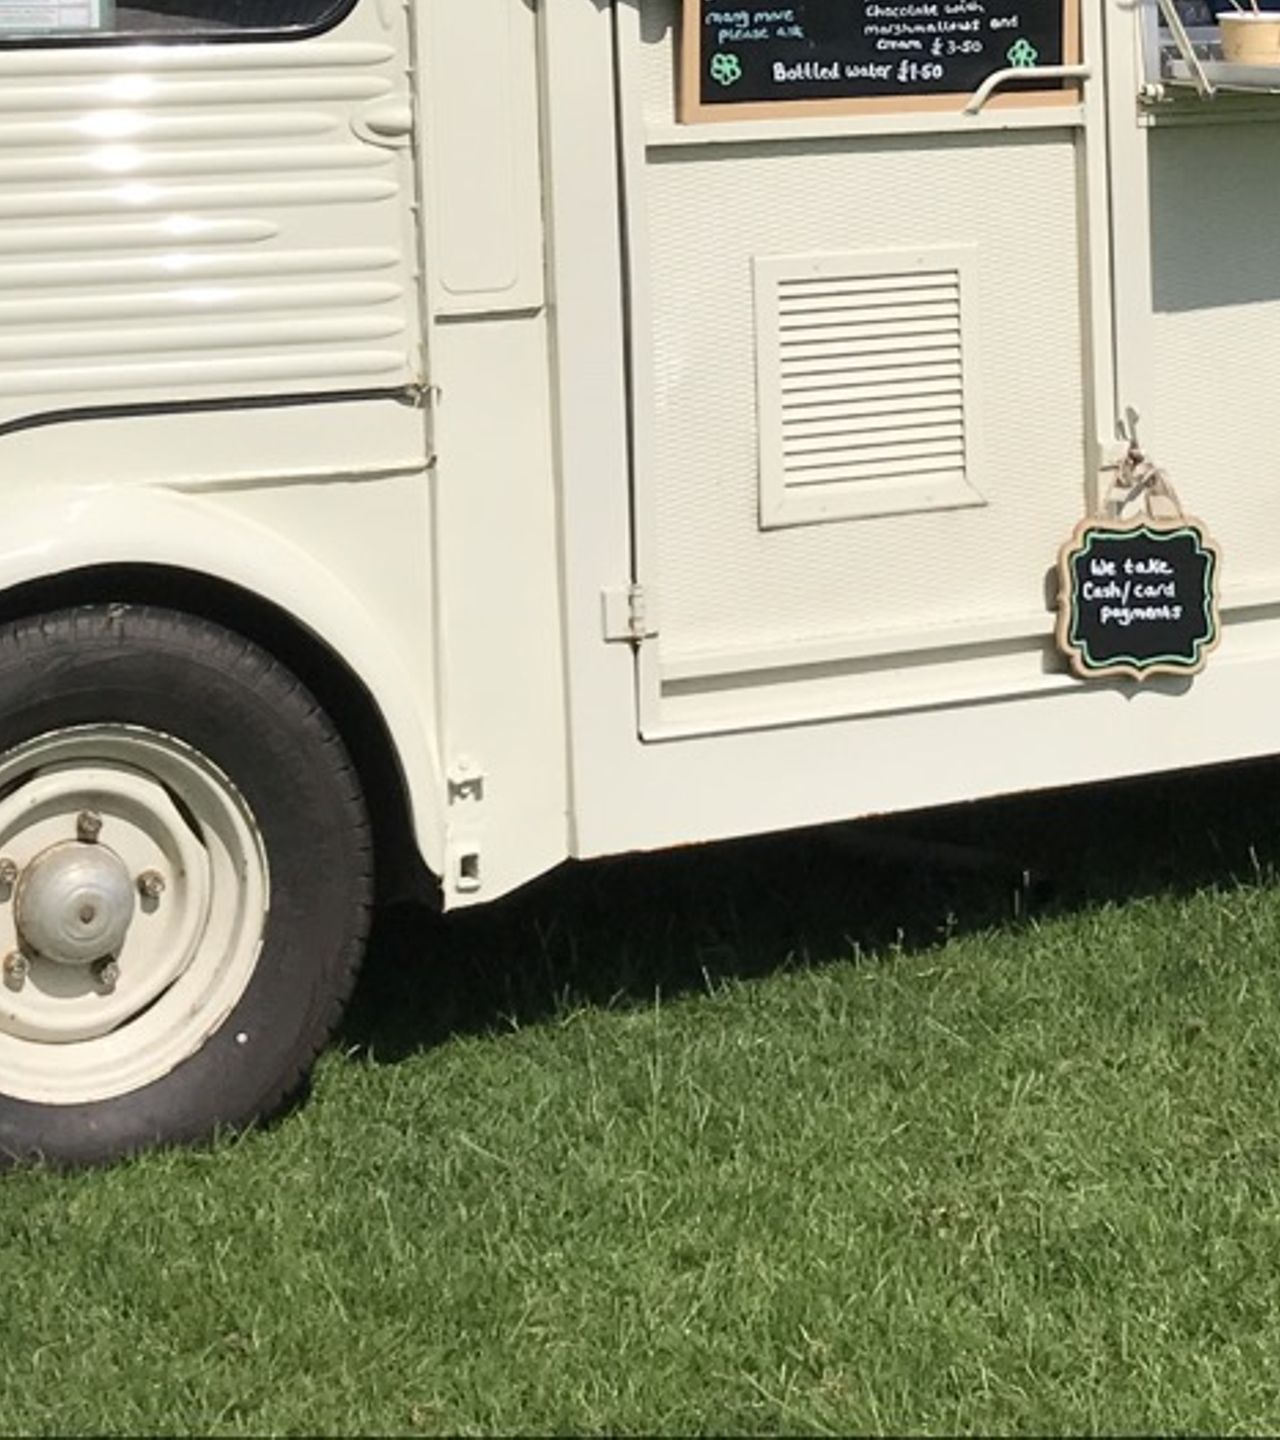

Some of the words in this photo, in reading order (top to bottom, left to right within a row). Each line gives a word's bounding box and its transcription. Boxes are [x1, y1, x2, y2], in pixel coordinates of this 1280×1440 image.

[773, 61, 840, 82] Bottled
[844, 63, 893, 80] water
[1090, 559, 1117, 577] We
